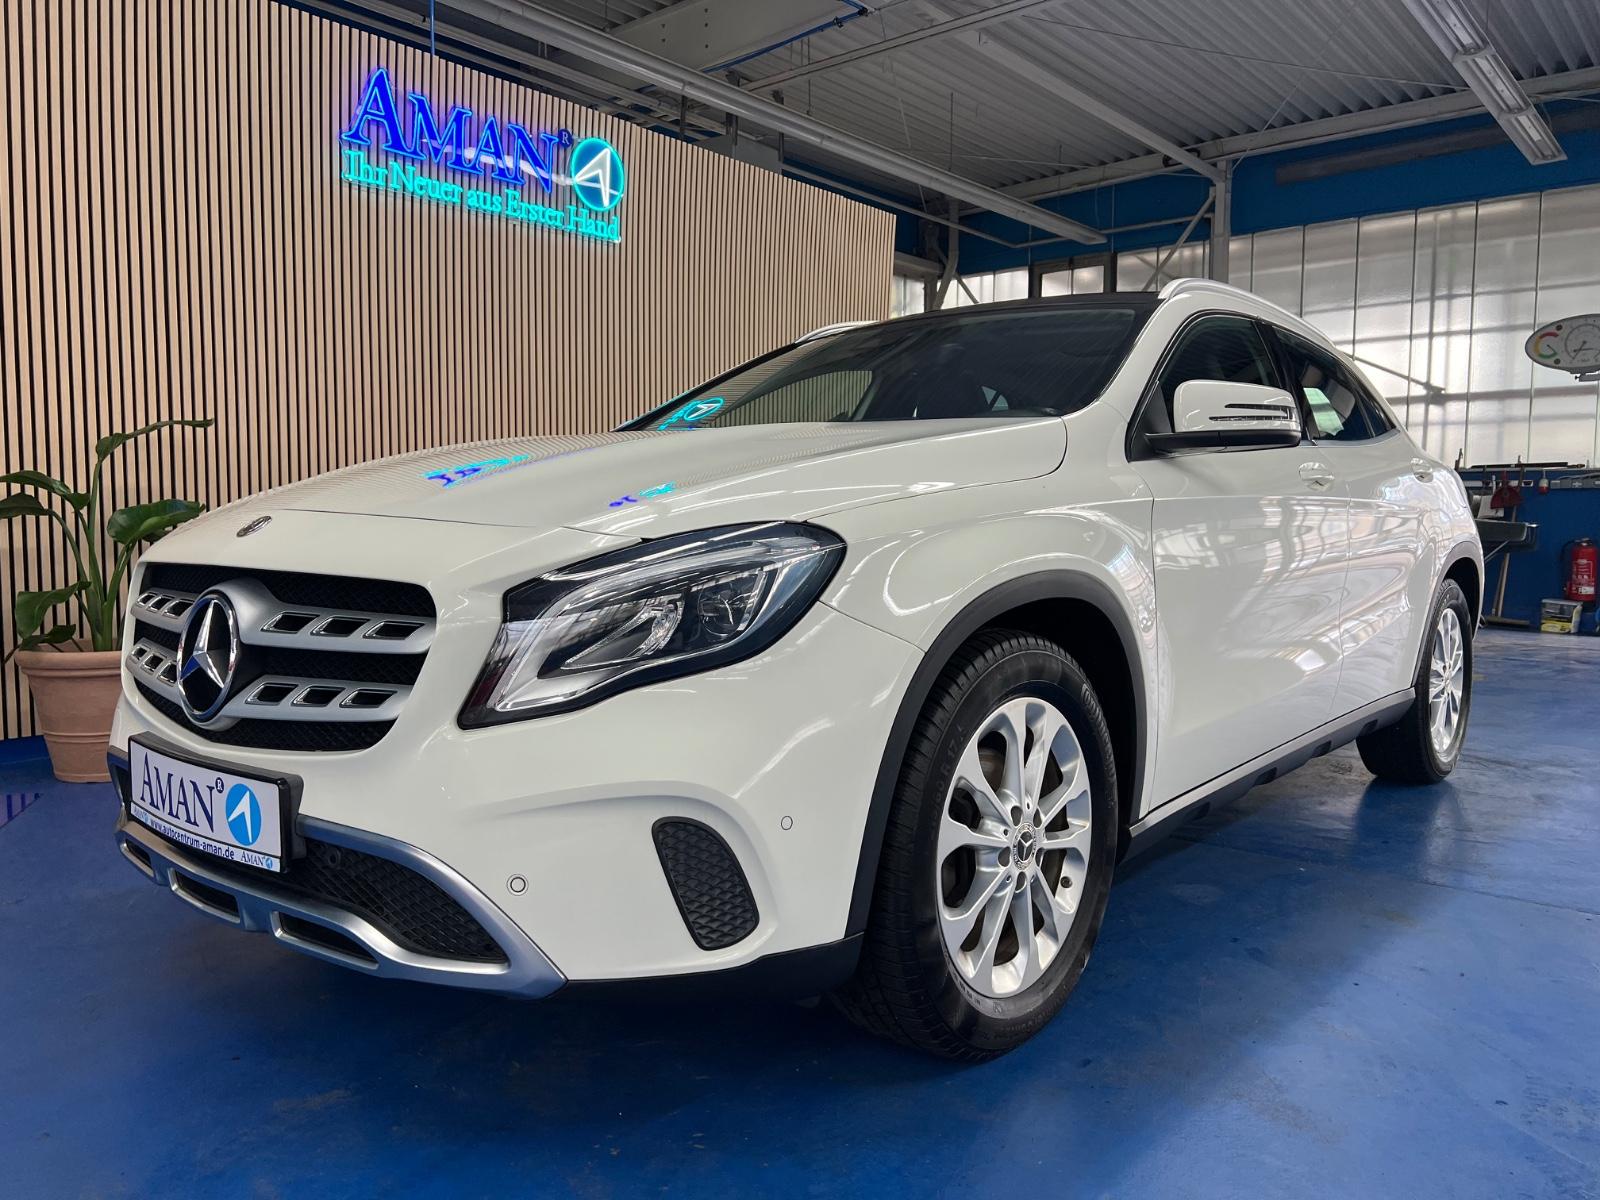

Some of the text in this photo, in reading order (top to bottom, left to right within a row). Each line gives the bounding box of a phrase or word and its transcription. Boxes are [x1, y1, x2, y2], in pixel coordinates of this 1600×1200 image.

[343, 150, 619, 239] Ihr Neuer aus Erster Hand
[150, 818, 235, 860] www.autocentrum-aman.de
